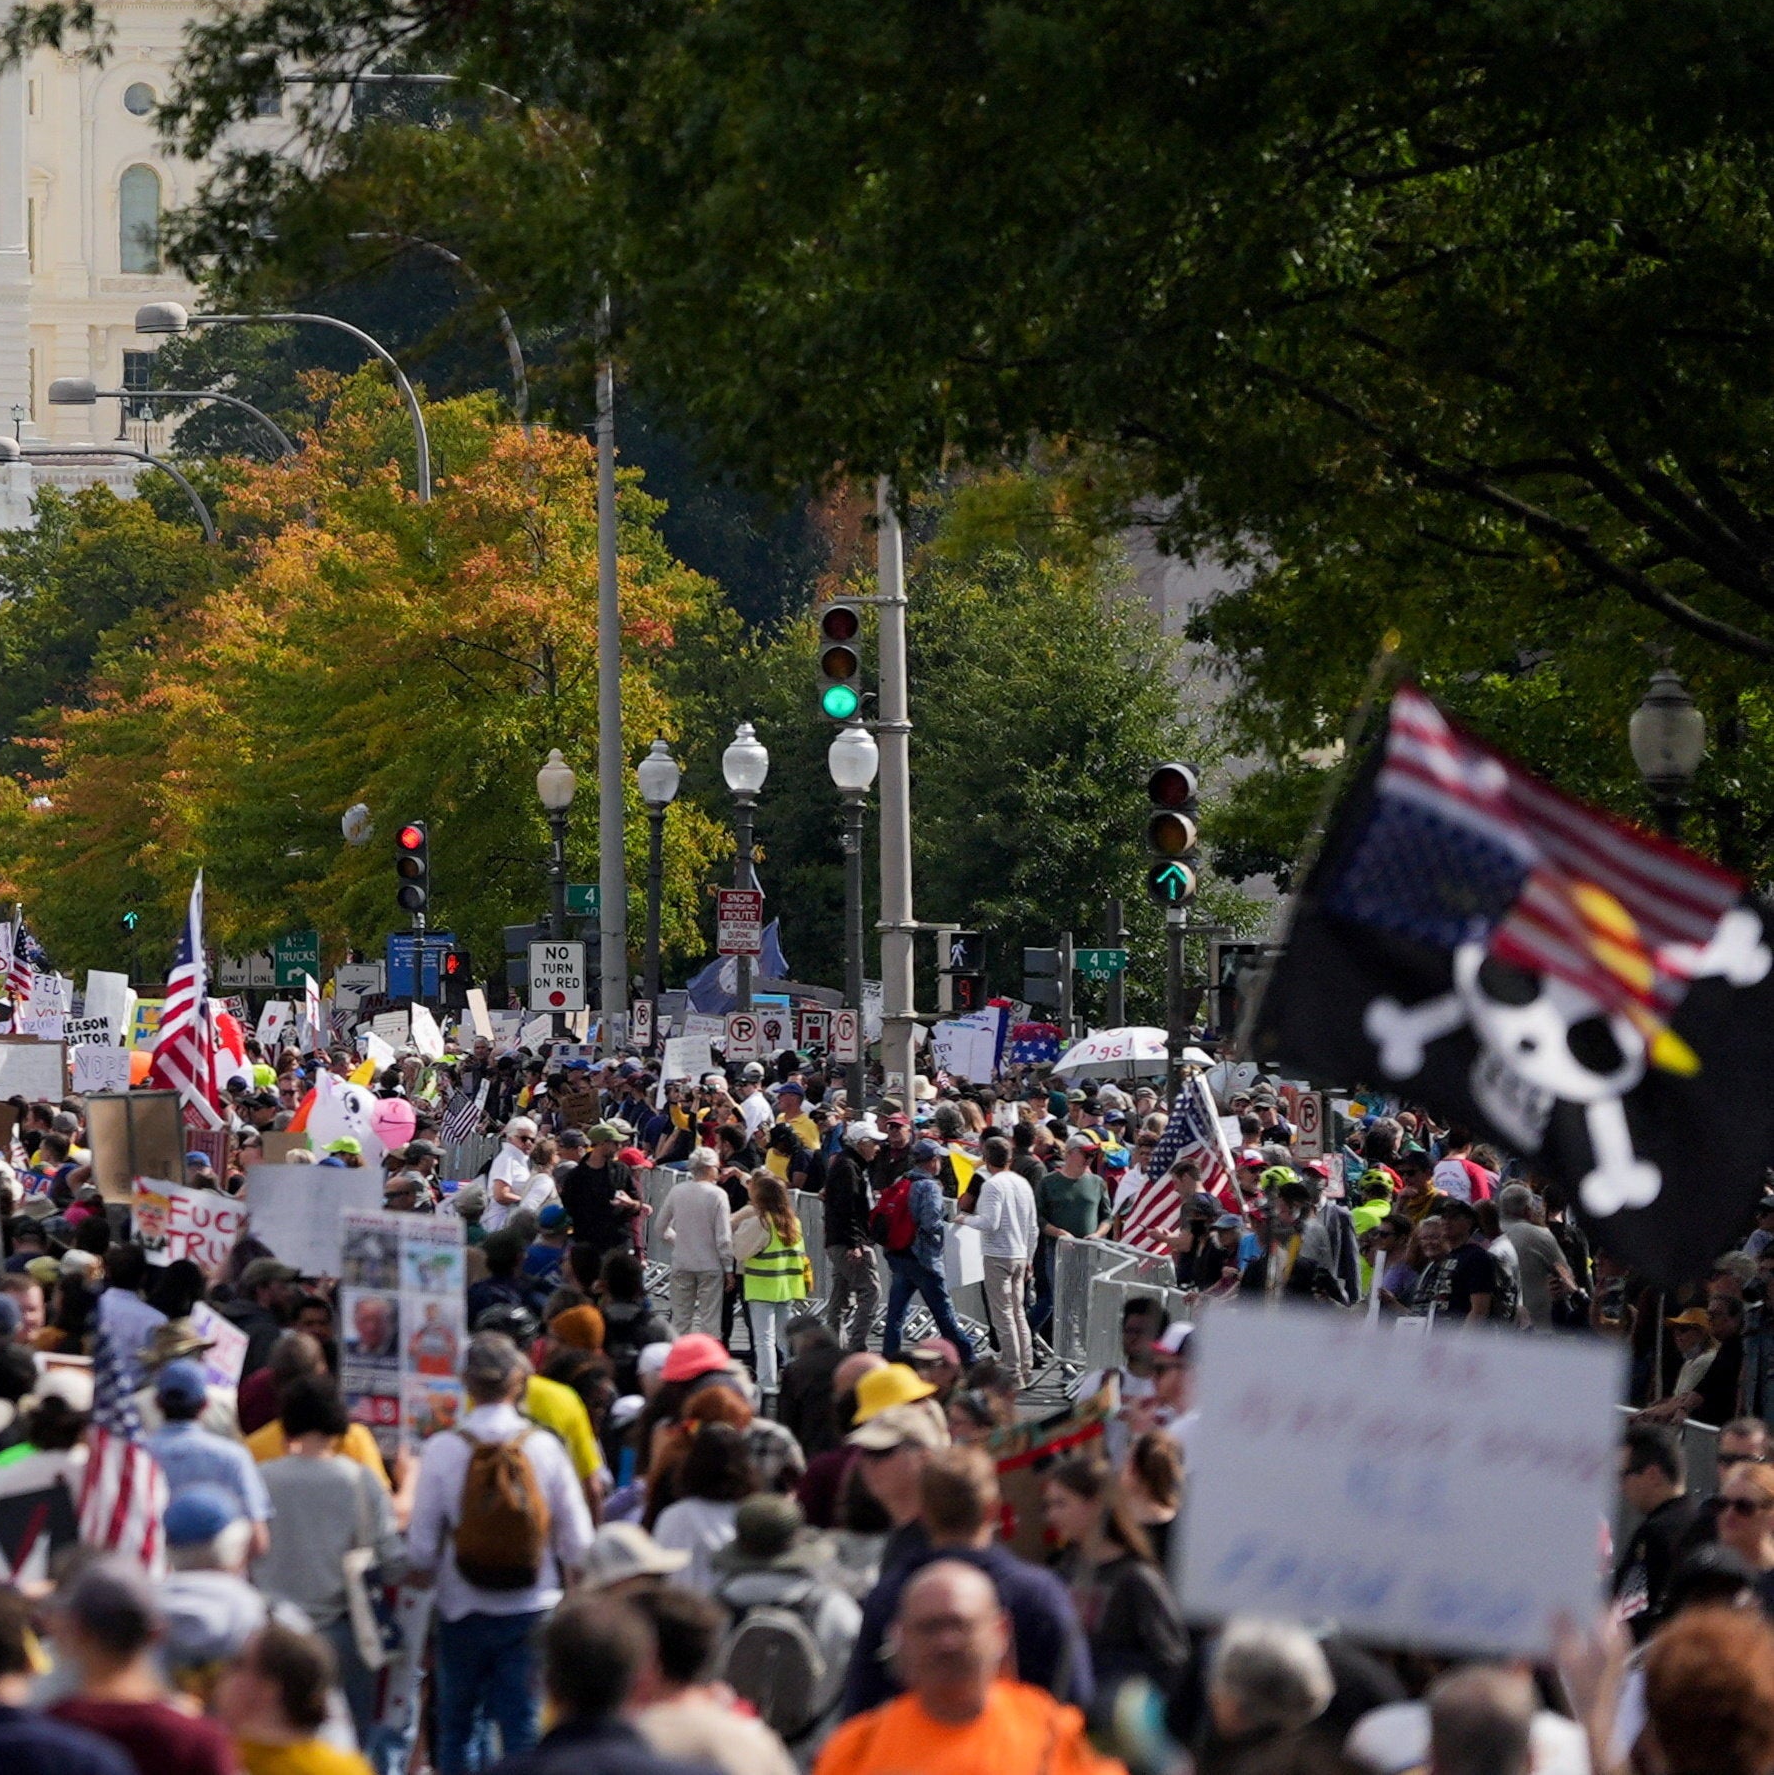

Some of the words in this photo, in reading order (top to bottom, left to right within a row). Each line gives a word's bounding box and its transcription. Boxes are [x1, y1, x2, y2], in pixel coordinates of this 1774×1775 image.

[584, 888, 595, 903] 4
[726, 893, 755, 903] SNOW
[723, 911, 757, 920] ROUTE
[278, 951, 316, 962] TRUCKS
[546, 946, 569, 960] NO
[1089, 953, 1099, 966] 4
[541, 963, 573, 974] TURN
[1089, 969, 1111, 979] 100
[222, 975, 246, 984] ONLY
[254, 975, 273, 984] ONL
[534, 977, 551, 988] ON
[556, 977, 580, 988] RED
